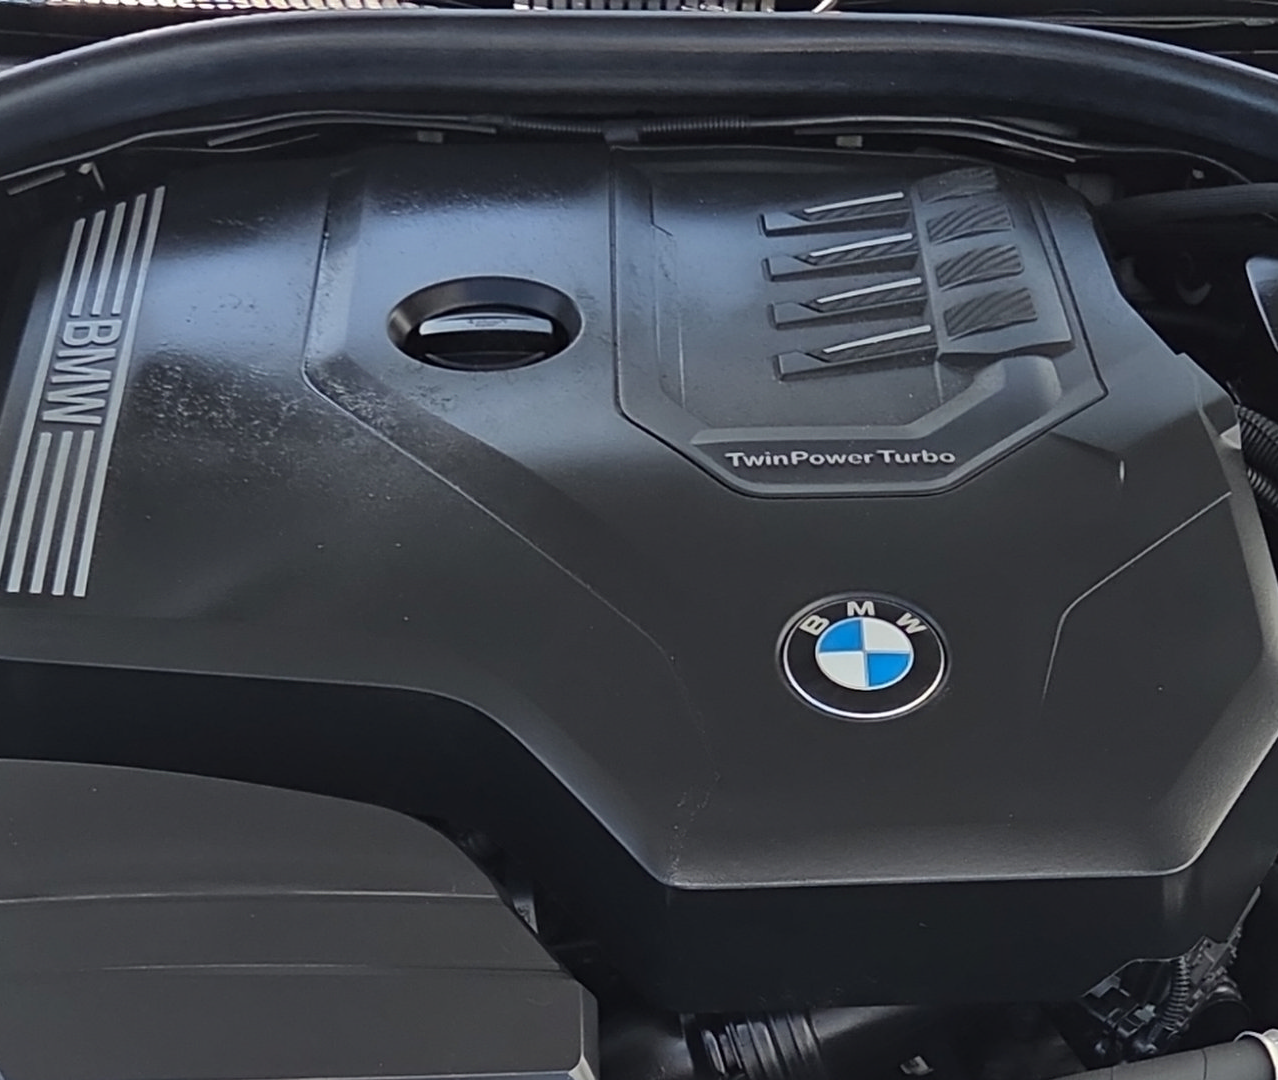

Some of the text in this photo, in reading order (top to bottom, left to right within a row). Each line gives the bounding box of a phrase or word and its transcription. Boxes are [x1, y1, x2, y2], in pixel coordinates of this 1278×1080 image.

[42, 319, 123, 426] BMW
[724, 449, 956, 467] TwinPower Turbo
[798, 600, 927, 637] BMW
